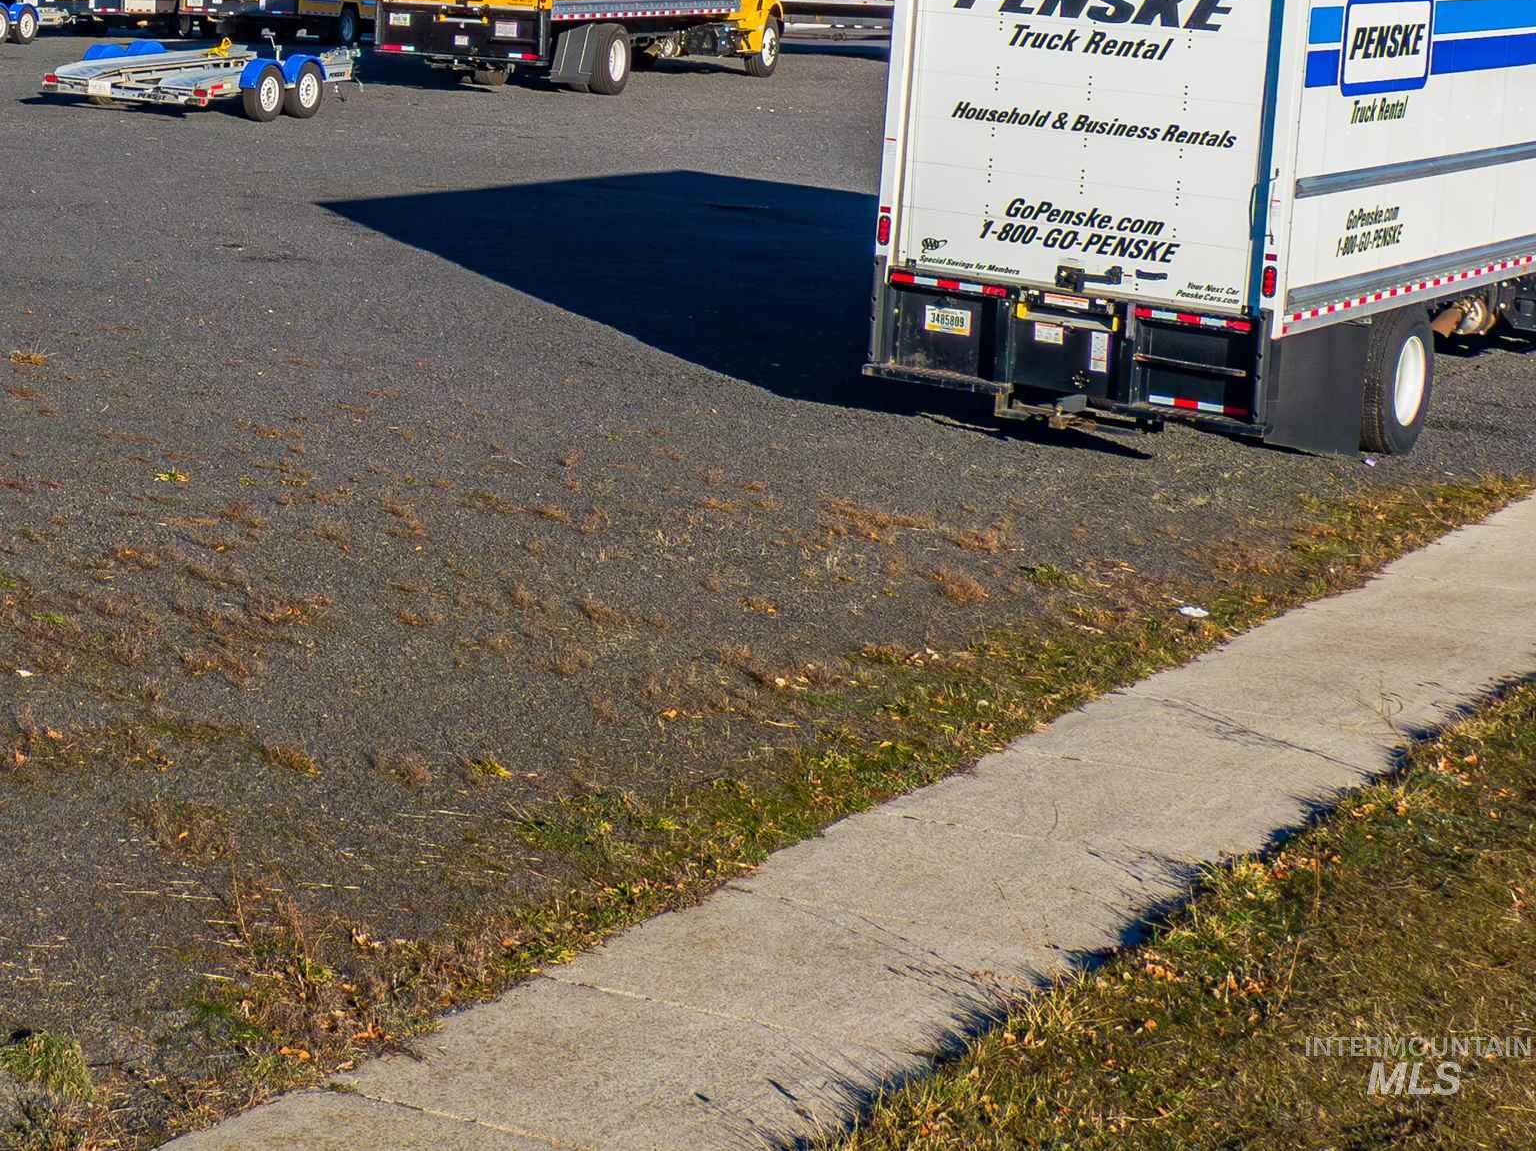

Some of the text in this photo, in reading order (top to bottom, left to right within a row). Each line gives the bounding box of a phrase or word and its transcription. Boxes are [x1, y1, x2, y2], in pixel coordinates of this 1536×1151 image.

[1007, 23, 1175, 61] Truck Rental
[1348, 23, 1426, 60] PENSKE
[951, 100, 1239, 150] Household & Business Rentals
[1350, 94, 1409, 125] Truck Rental
[1004, 196, 1165, 237] GoPenske.com
[1346, 204, 1400, 231] GoPenske.com
[978, 219, 1181, 265] 1-800-GO-PENSKE
[1335, 223, 1404, 258] 1-800-GO-PENSKE
[919, 254, 1021, 276] Special Savings for Members
[1187, 281, 1240, 296] Your Next Car
